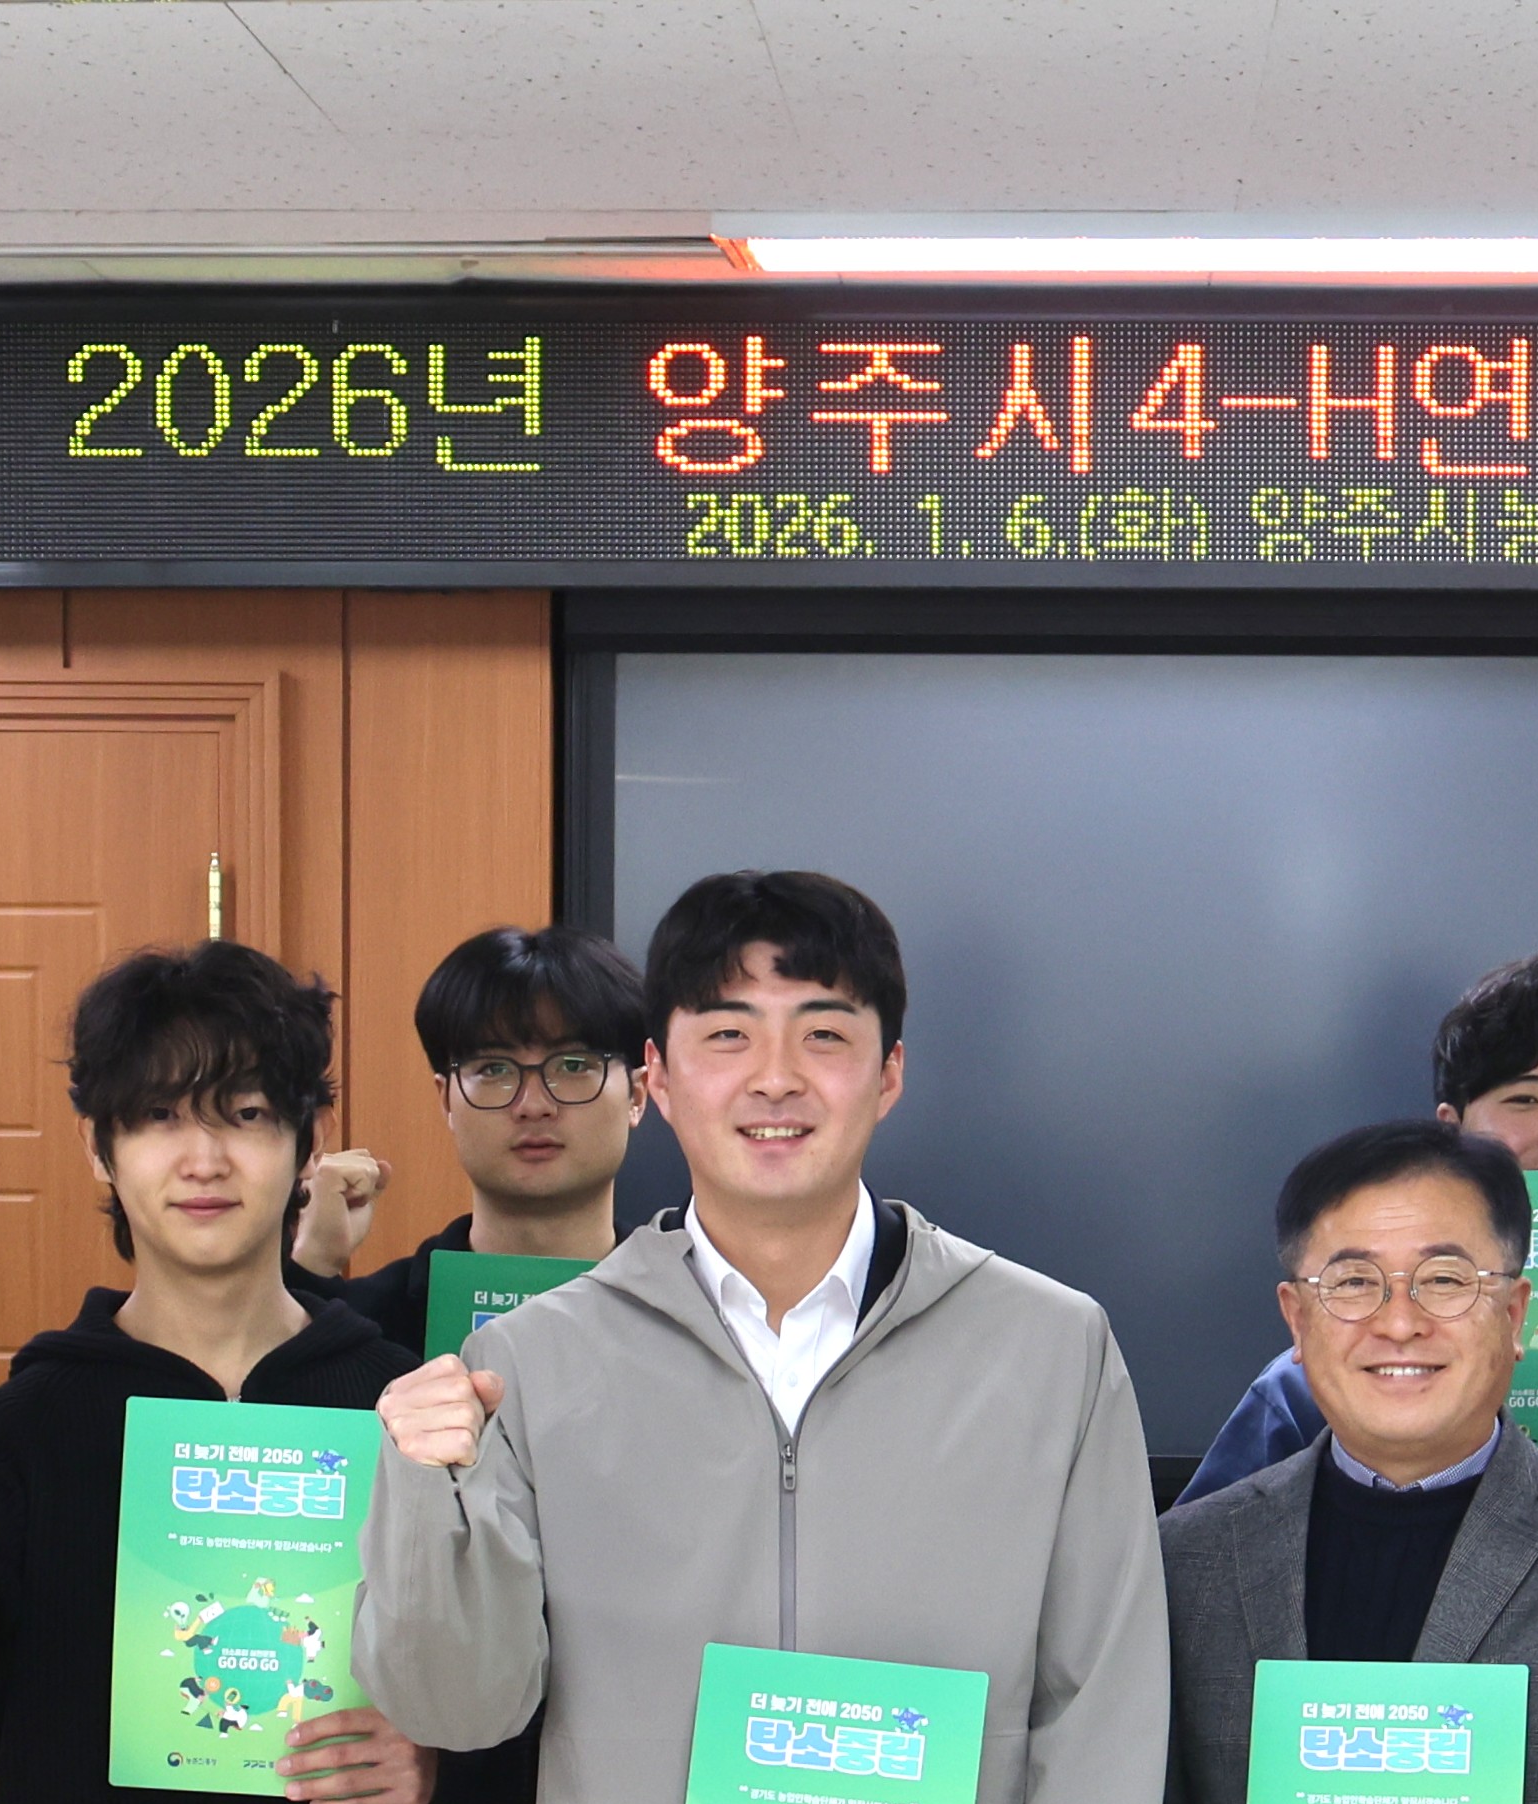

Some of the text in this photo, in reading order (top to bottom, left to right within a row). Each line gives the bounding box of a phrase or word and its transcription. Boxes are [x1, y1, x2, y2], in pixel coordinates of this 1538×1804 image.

[66, 336, 542, 472] 2026년
[686, 491, 875, 557] 2026.
[918, 491, 970, 557] 1.
[474, 1291, 518, 1307] 더 늦기
[1507, 1395, 1525, 1408] GO
[174, 1442, 303, 1464] 더 늦기 전에 2050
[171, 1465, 346, 1519] 탄소중립
[179, 1535, 204, 1546] 경기도
[217, 1654, 279, 1671] GO GO GO
[750, 1692, 882, 1721] 더 늦기 전에 2050
[1301, 1702, 1429, 1720] 더 늦기 전에 2050
[745, 1716, 925, 1780] 탄소중립
[1299, 1725, 1471, 1774] 탄소중립
[750, 1787, 775, 1800] 경기도
[1306, 1793, 1331, 1804] 경기도
